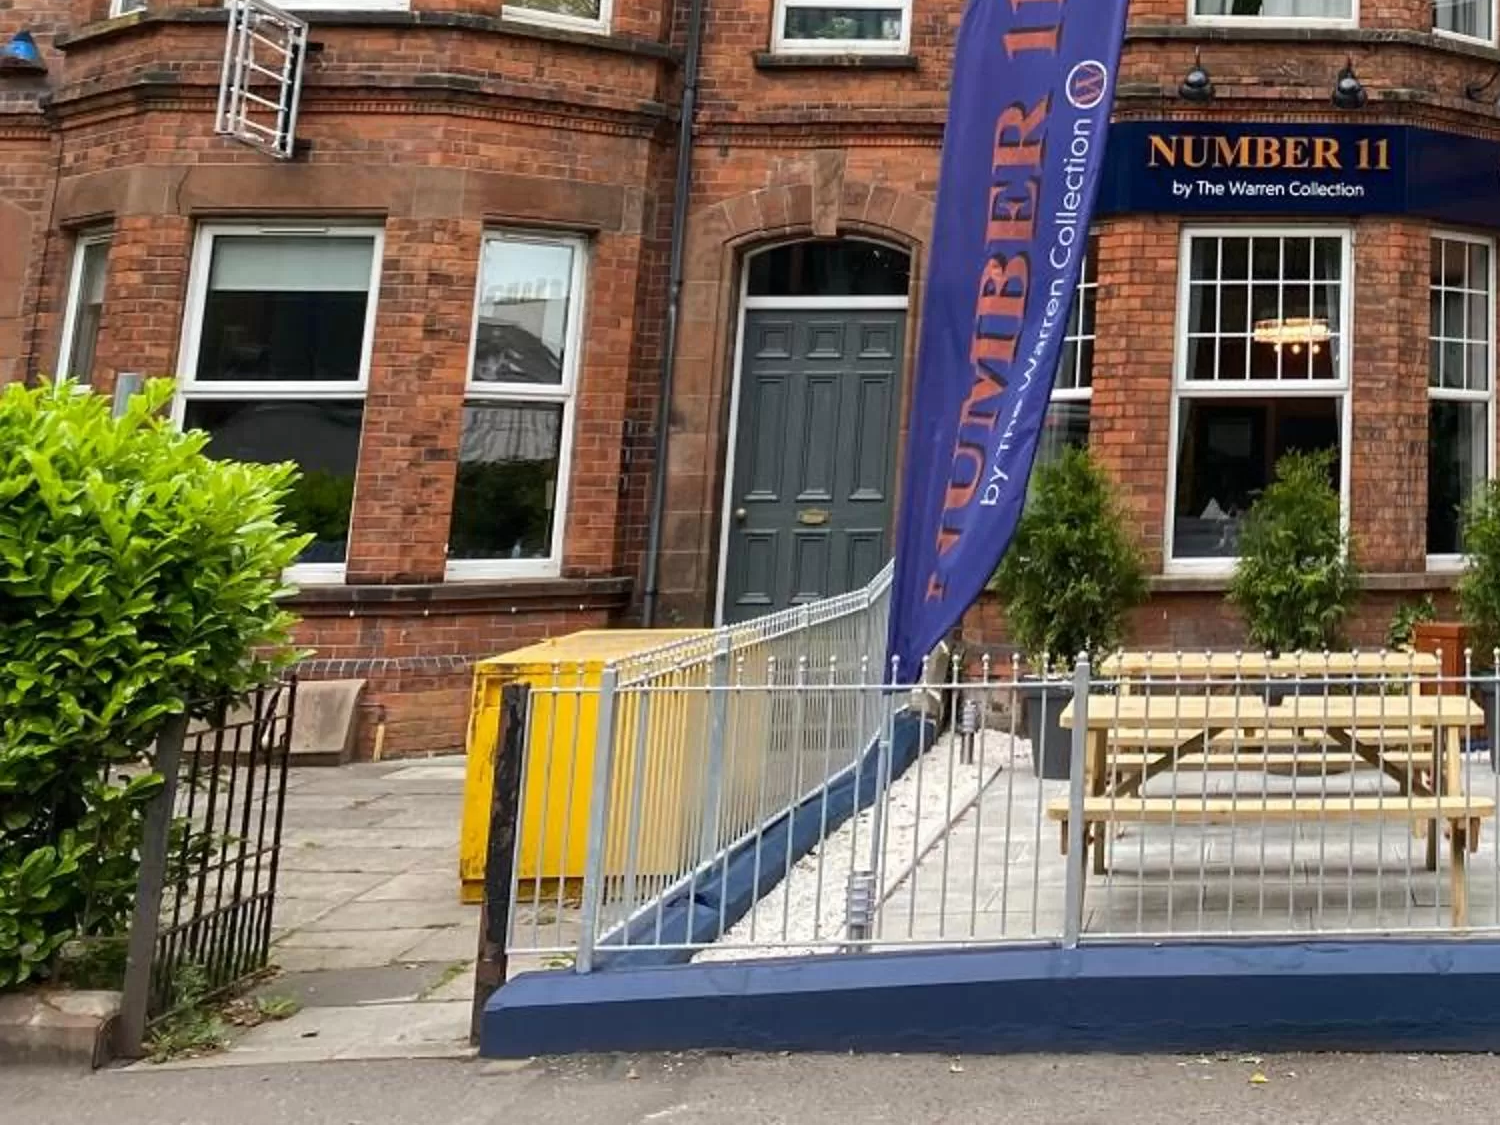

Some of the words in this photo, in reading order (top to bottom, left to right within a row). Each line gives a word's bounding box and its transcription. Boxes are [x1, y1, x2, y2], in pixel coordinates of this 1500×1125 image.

[1147, 133, 1343, 169] NUMBER
[1353, 137, 1393, 171] 11
[1172, 178, 1193, 199] by
[1196, 180, 1226, 196] The
[1229, 181, 1286, 196] Warren
[1288, 181, 1365, 198] Collection
[979, 463, 1010, 507] by
[1050, 118, 1092, 269] Collection
